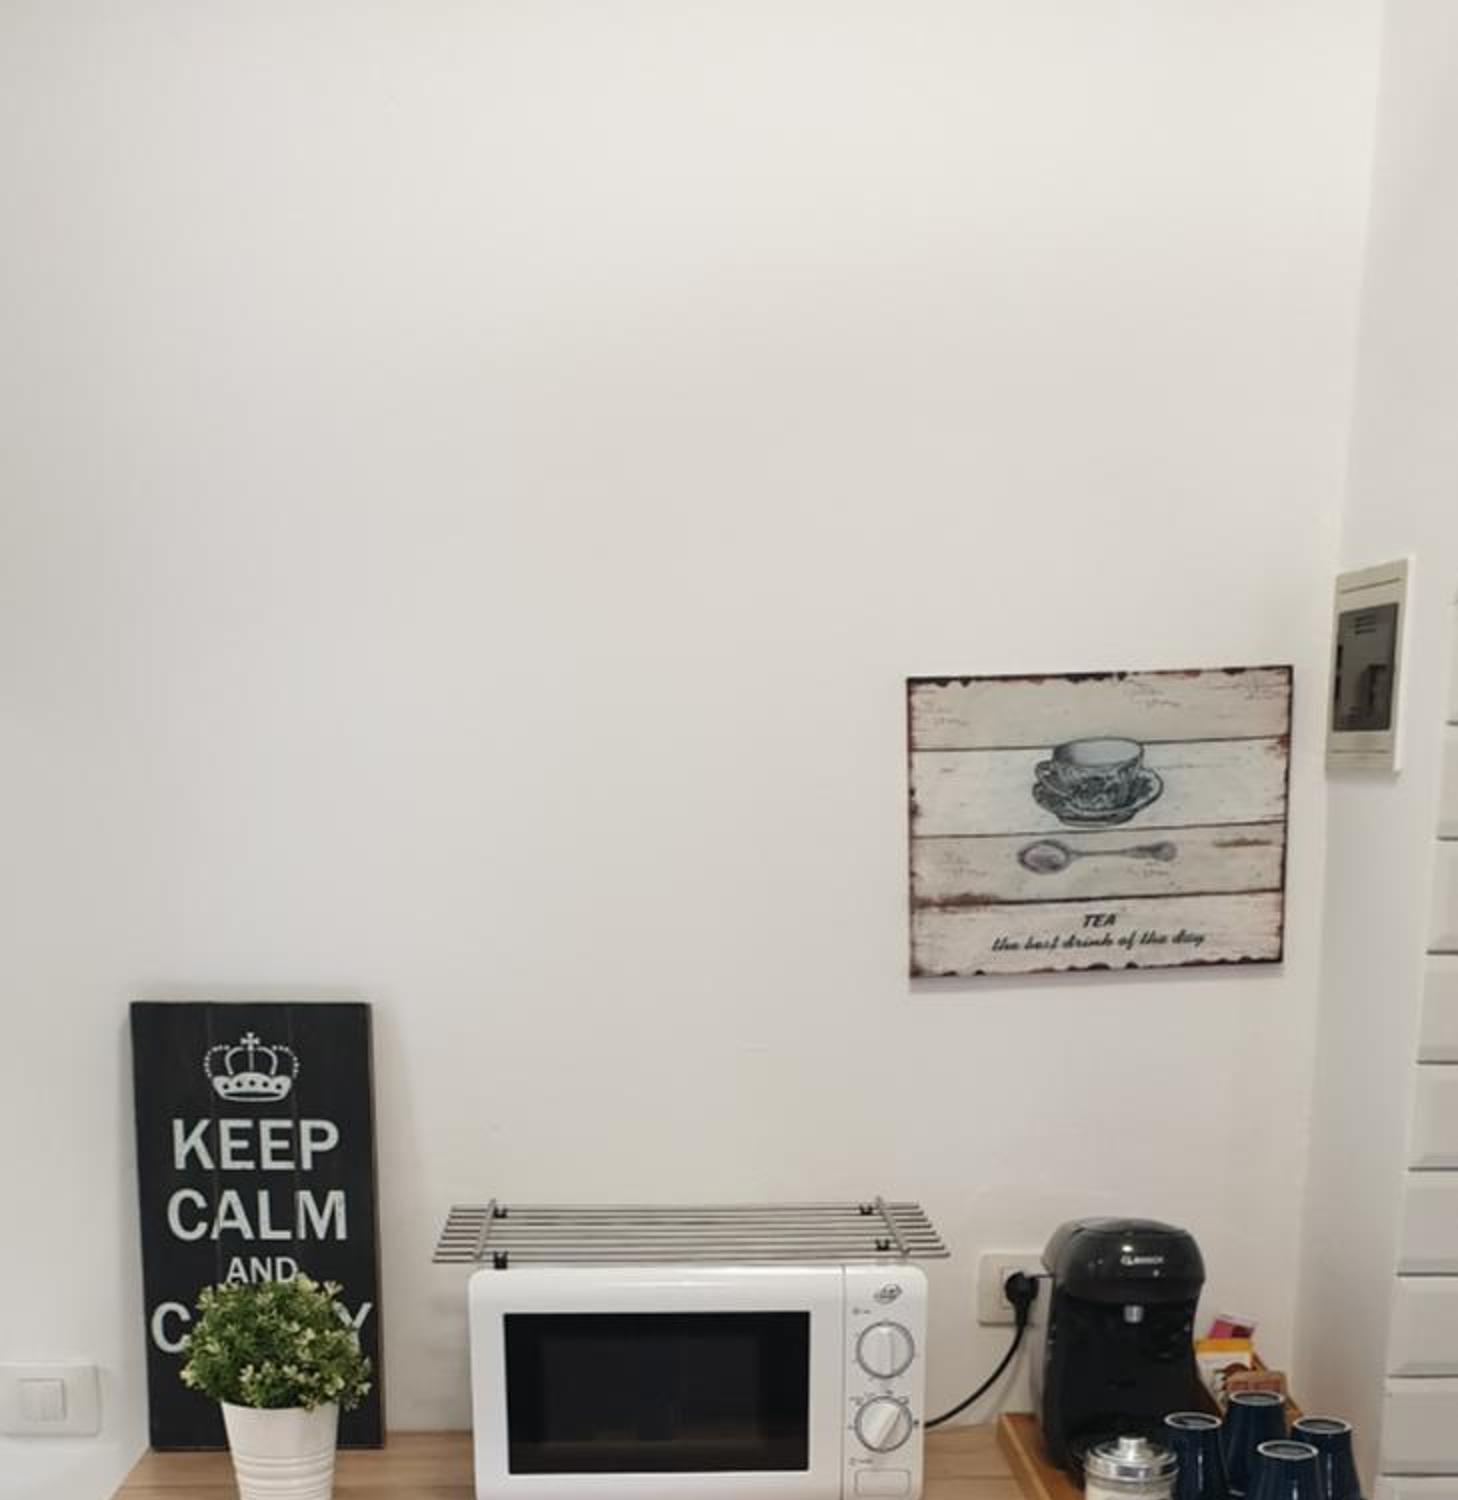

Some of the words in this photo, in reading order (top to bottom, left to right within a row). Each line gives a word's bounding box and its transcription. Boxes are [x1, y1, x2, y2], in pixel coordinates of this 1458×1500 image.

[1083, 913, 1117, 928] TEA
[992, 936, 1019, 951] the
[1024, 936, 1060, 950] best
[1063, 934, 1113, 948] drink
[1117, 931, 1138, 950] of
[1140, 931, 1167, 945] the
[1172, 929, 1205, 948] day
[172, 1118, 340, 1170] KEEP
[166, 1188, 348, 1241] CALM
[225, 1256, 298, 1284] AND
